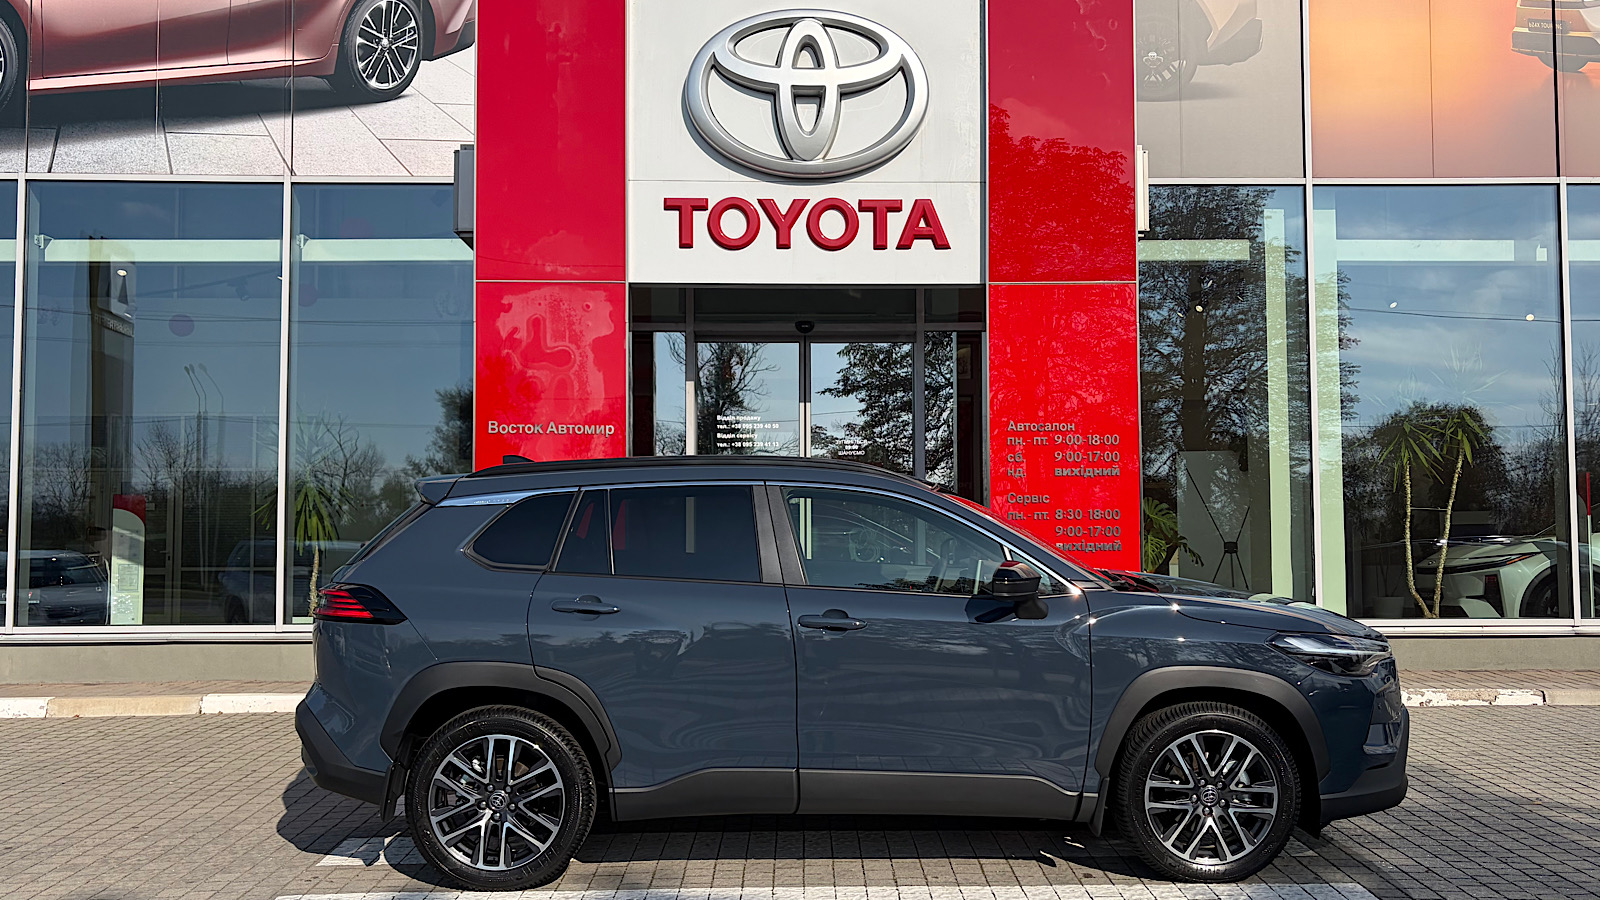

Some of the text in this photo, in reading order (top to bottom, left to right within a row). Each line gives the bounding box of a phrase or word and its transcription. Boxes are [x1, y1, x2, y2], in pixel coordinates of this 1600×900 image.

[664, 197, 951, 251] TOYOTA
[487, 420, 615, 437] Восток Автомир
[1007, 420, 1076, 432] Автосалон
[1054, 434, 1120, 446] 9:00-18:00
[1054, 451, 1120, 462] 9:00-17:00
[1054, 465, 1120, 478] вихідний
[1007, 492, 1050, 506] Сервіс
[1055, 526, 1121, 537] 9:00-17:00
[1056, 540, 1122, 553] вихідний
